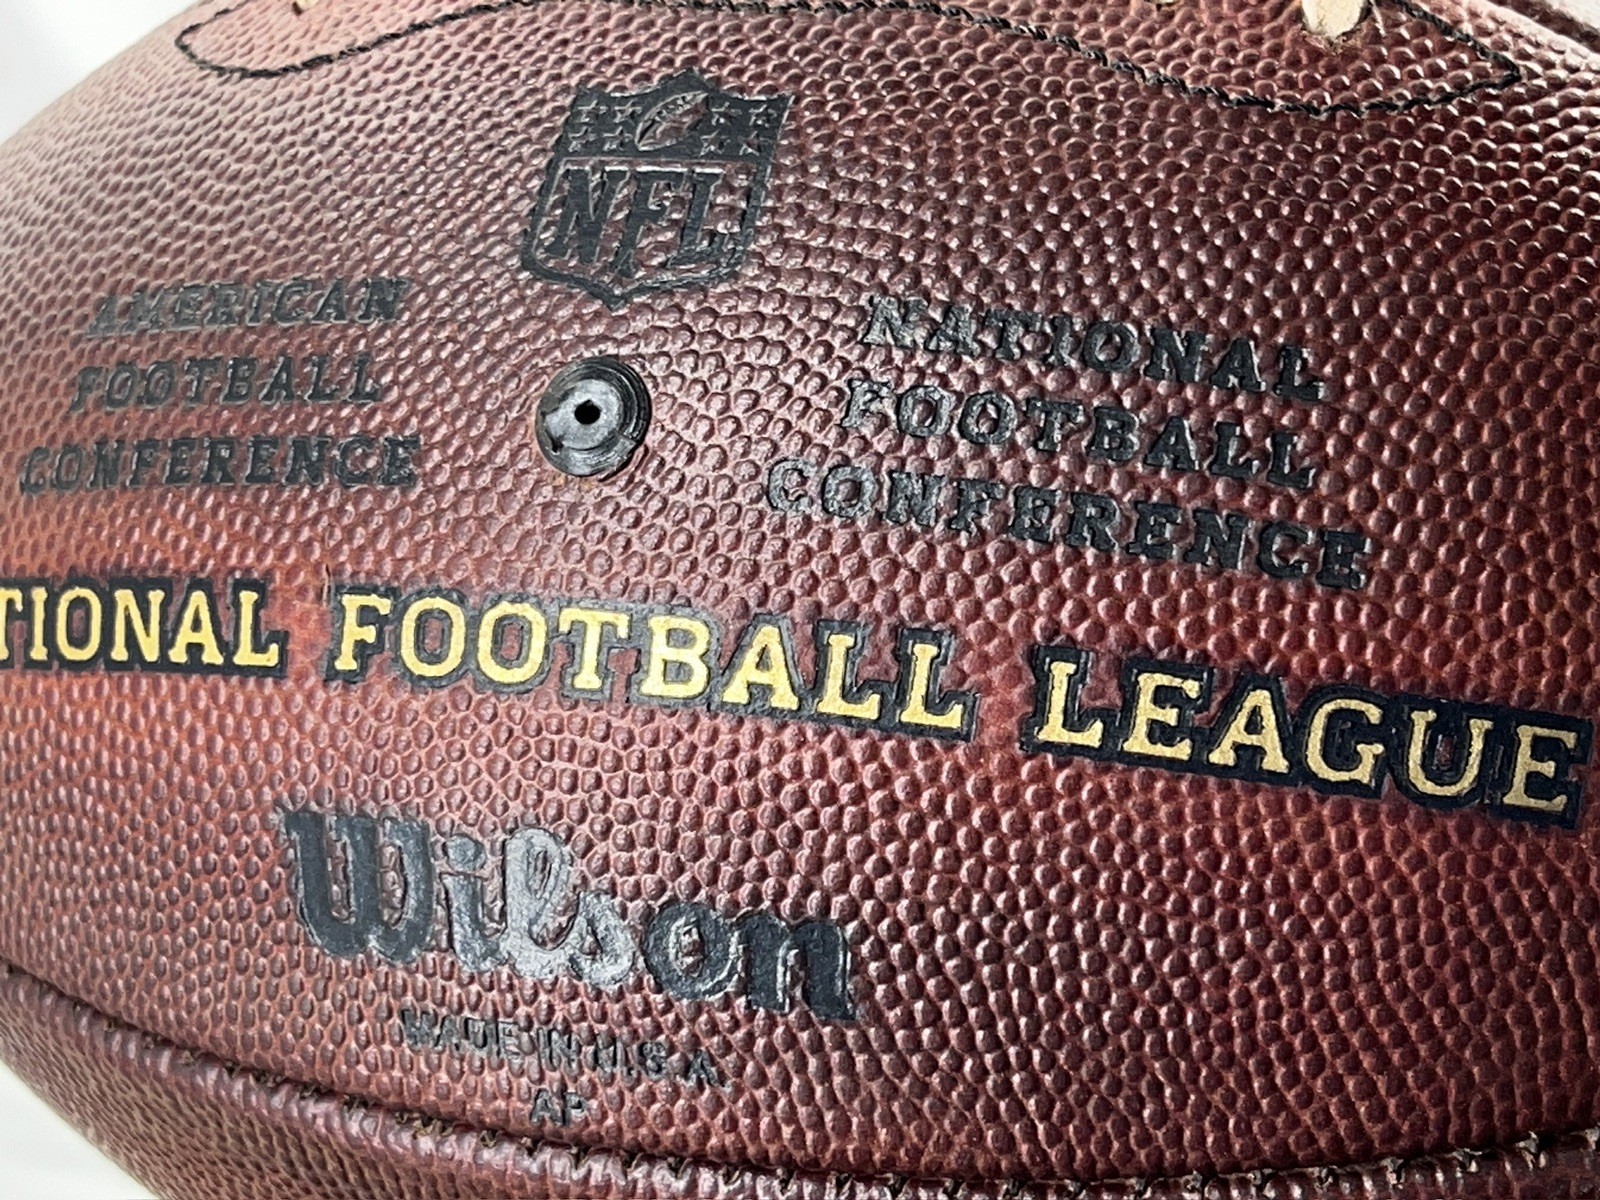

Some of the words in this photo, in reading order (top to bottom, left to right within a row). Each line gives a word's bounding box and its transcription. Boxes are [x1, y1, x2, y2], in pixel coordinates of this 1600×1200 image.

[538, 166, 732, 279] NFL
[86, 277, 411, 338] AMERICAN
[863, 296, 1327, 401] NATIONAL
[69, 354, 384, 413] FOOTBALL
[841, 378, 1317, 490] FOOTBALL
[20, 434, 422, 496] CONFERENCE
[766, 459, 1371, 590] CONFERENCE
[334, 593, 964, 730] FOOTBALL
[1035, 661, 1577, 813] LEAGUE
[278, 806, 858, 1022] Wilson
